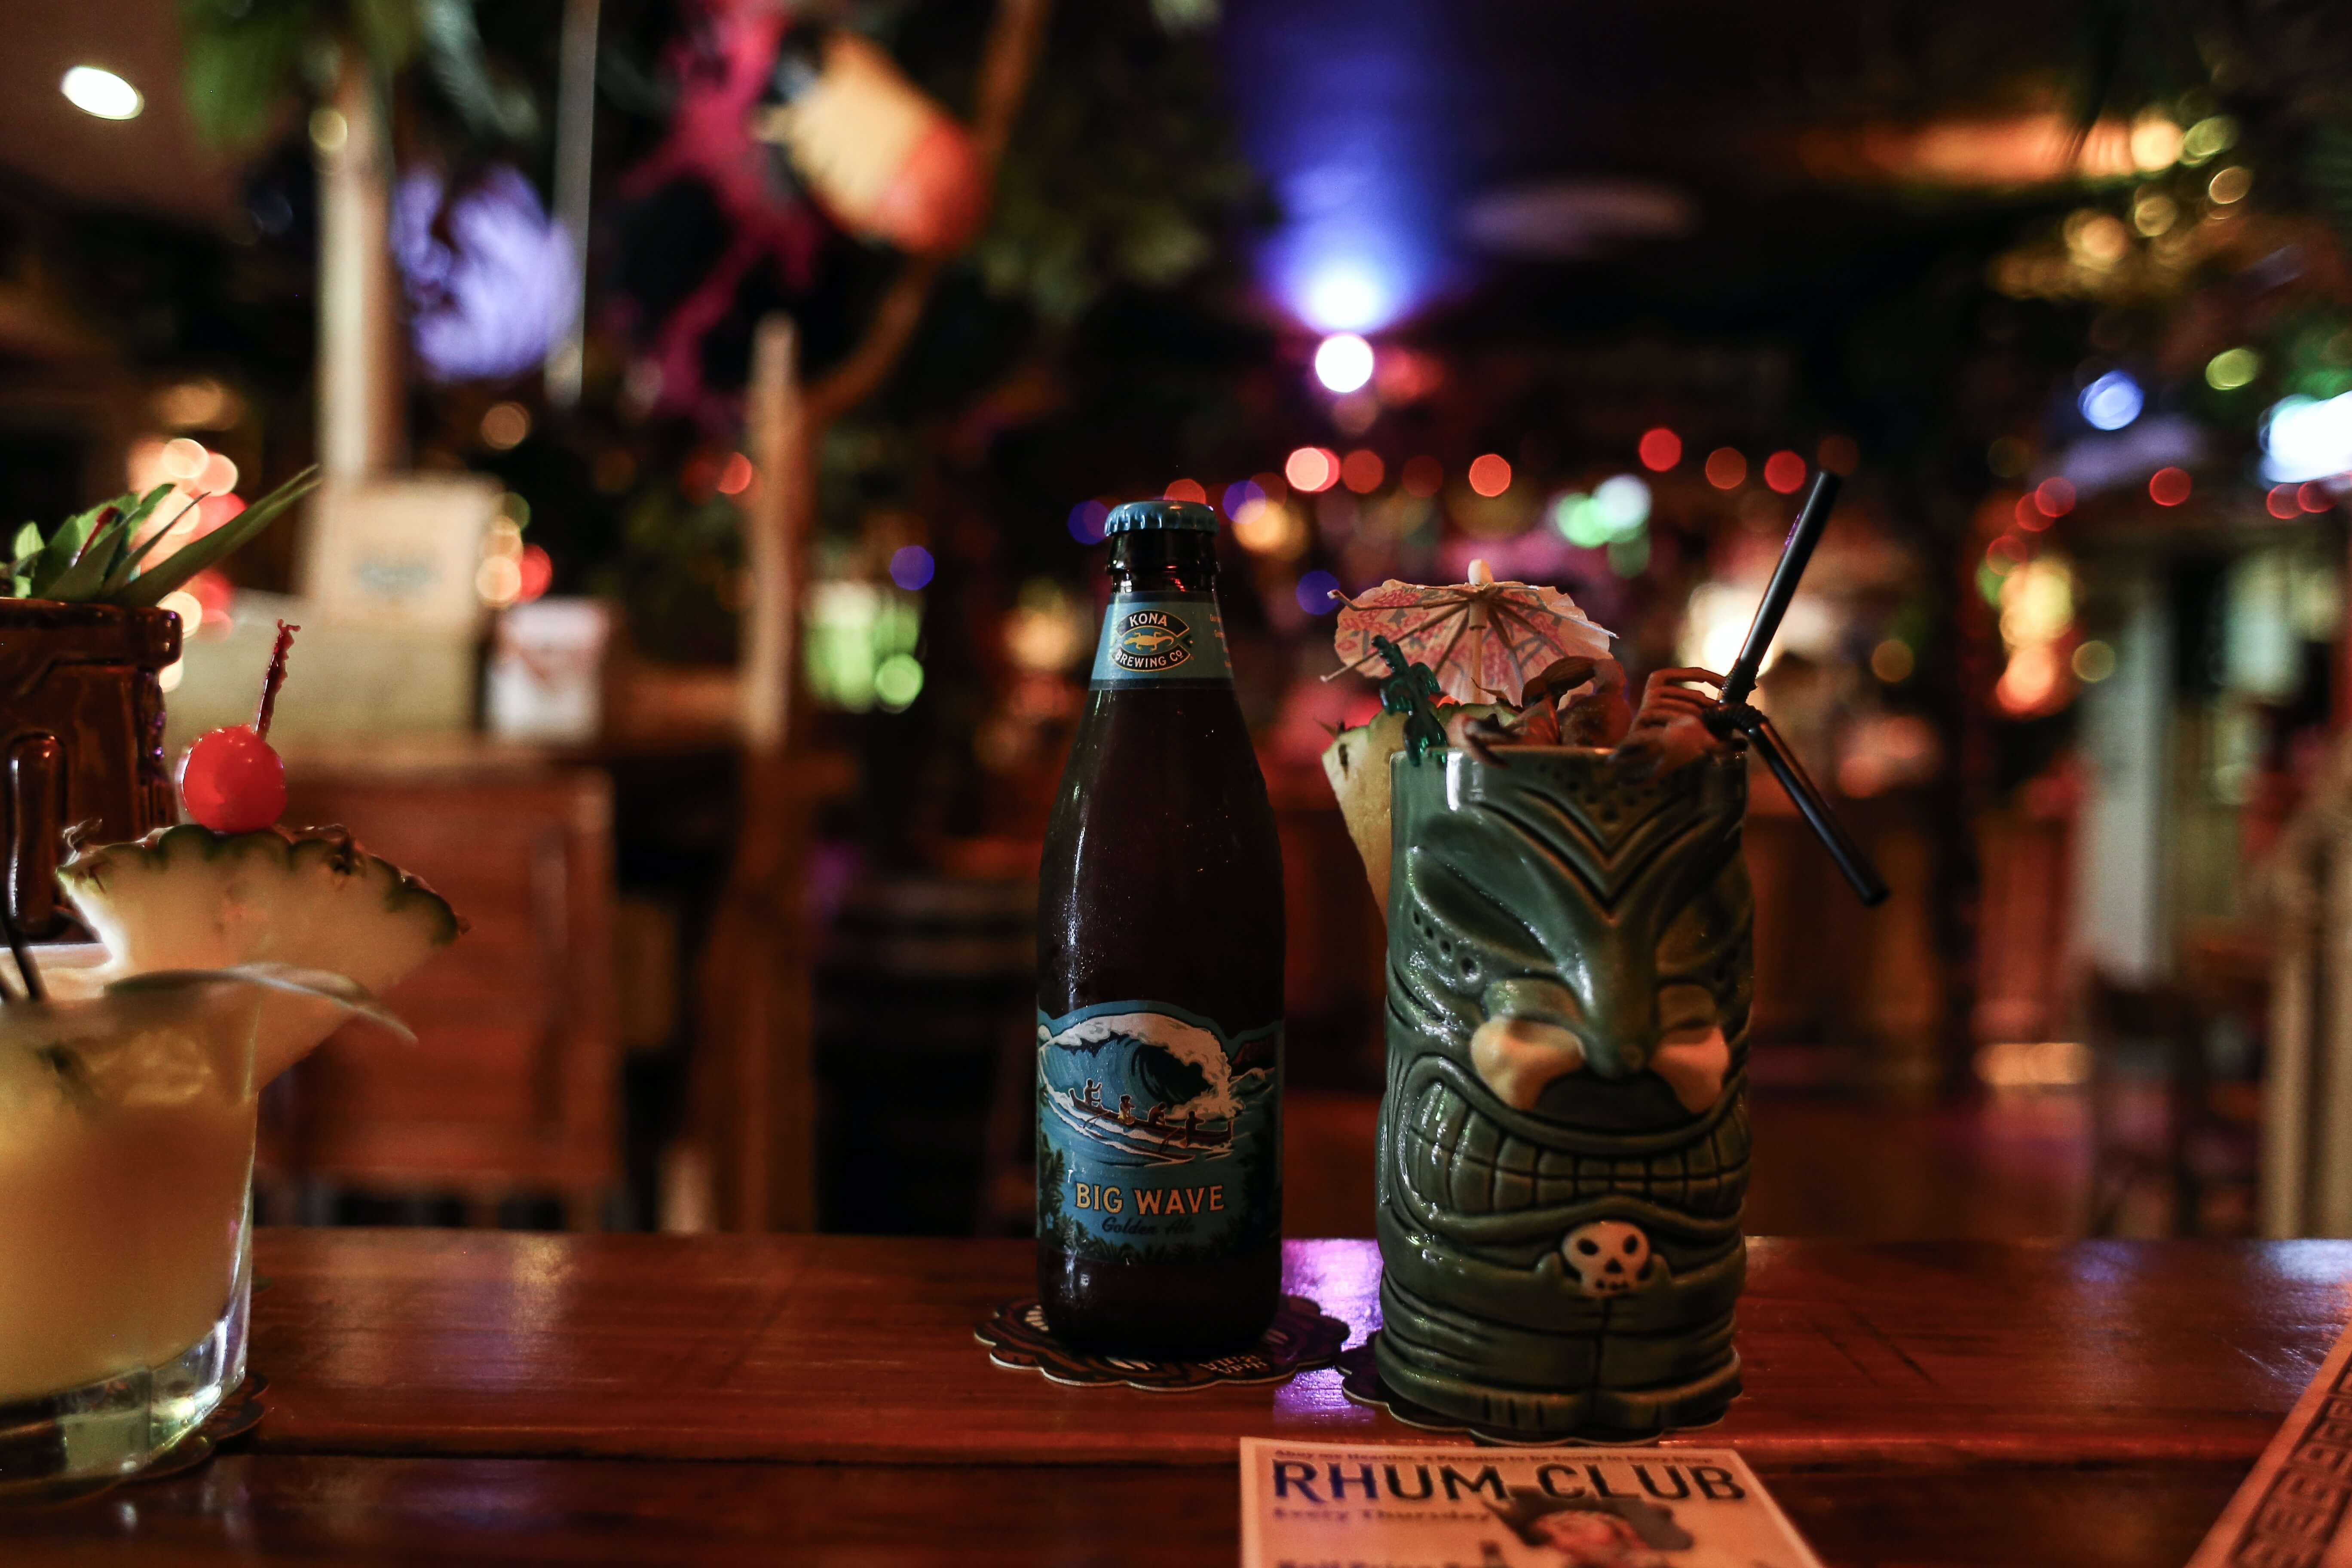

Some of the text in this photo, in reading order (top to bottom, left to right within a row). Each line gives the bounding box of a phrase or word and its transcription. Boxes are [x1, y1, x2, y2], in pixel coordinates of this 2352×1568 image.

[1130, 613, 1167, 627] KONA
[1116, 648, 1167, 668] BREWING
[1076, 1182, 1225, 1215] BIG WAVE
[1102, 1216, 1197, 1235] Golden Ale
[1272, 1459, 1746, 1503] RHUM CLUB
